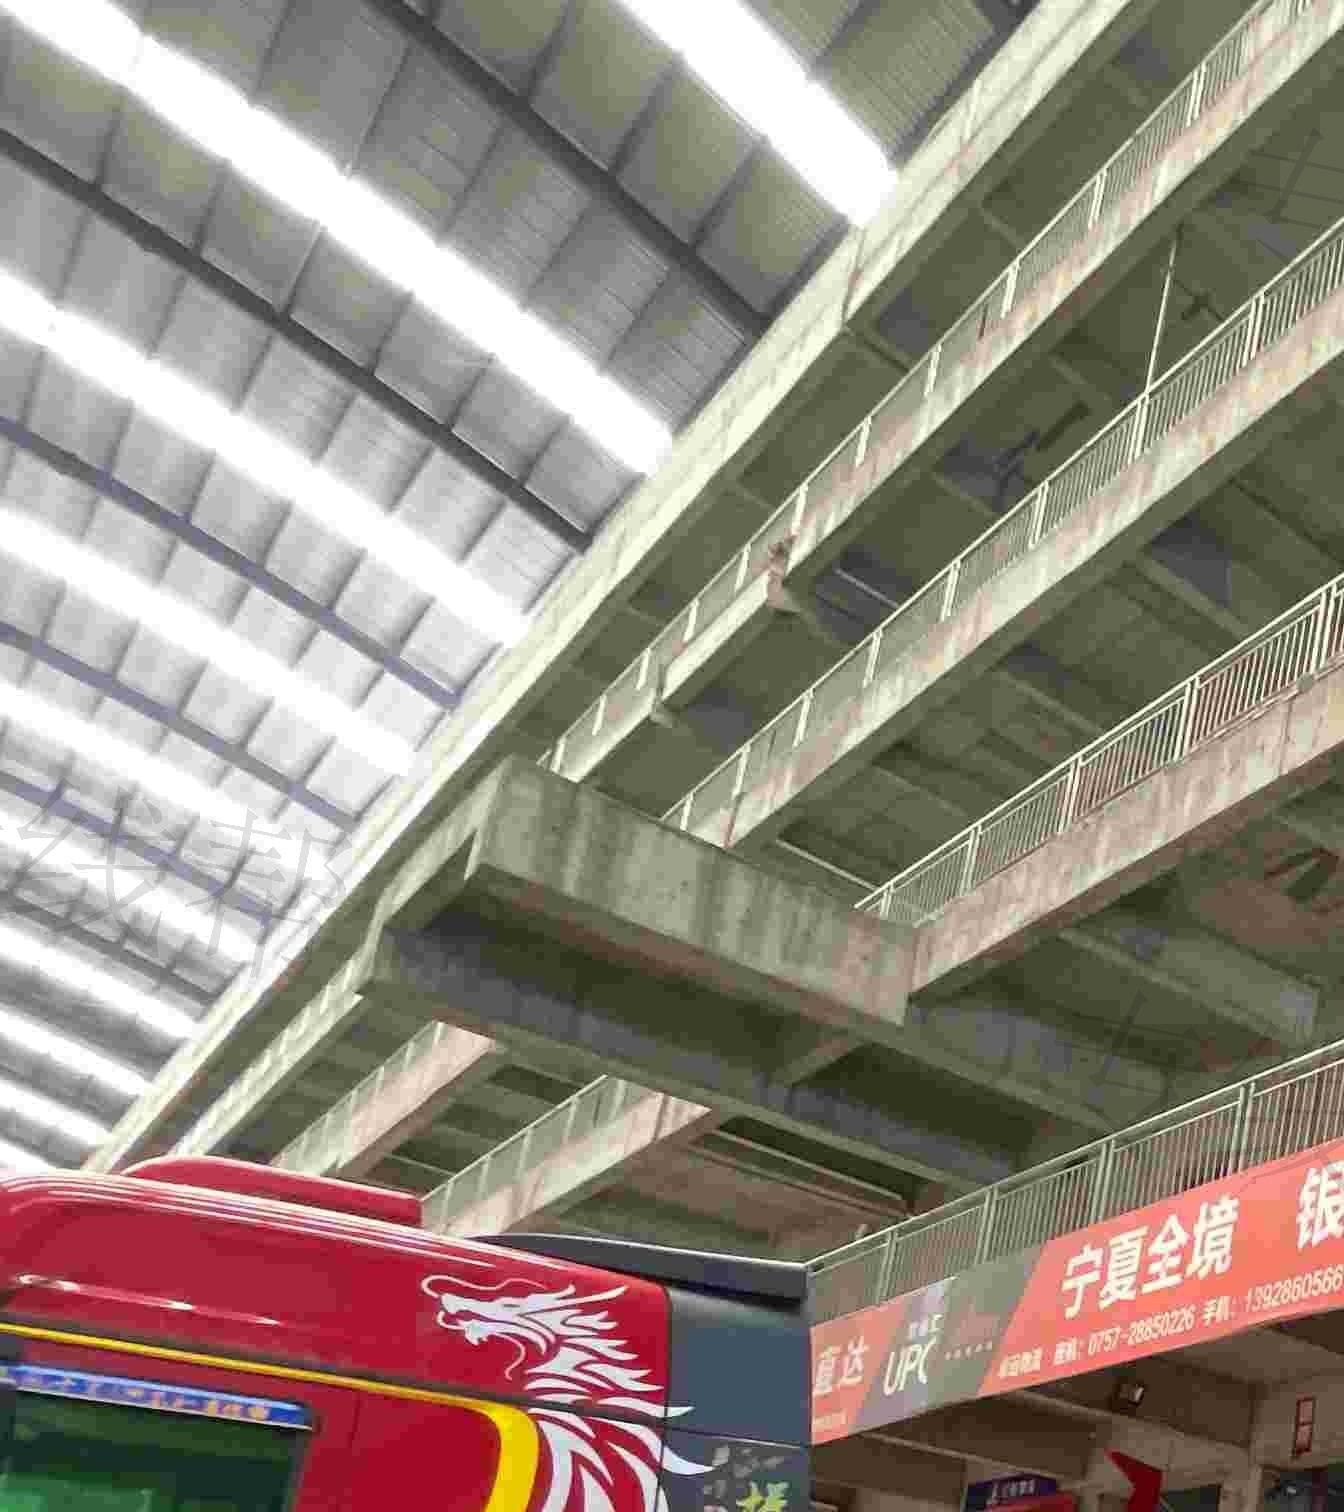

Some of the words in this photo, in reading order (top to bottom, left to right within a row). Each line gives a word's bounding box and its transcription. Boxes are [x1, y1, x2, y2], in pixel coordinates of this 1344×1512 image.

[1061, 1194, 1240, 1320] 宁夏全境
[882, 1340, 937, 1396] UPC
